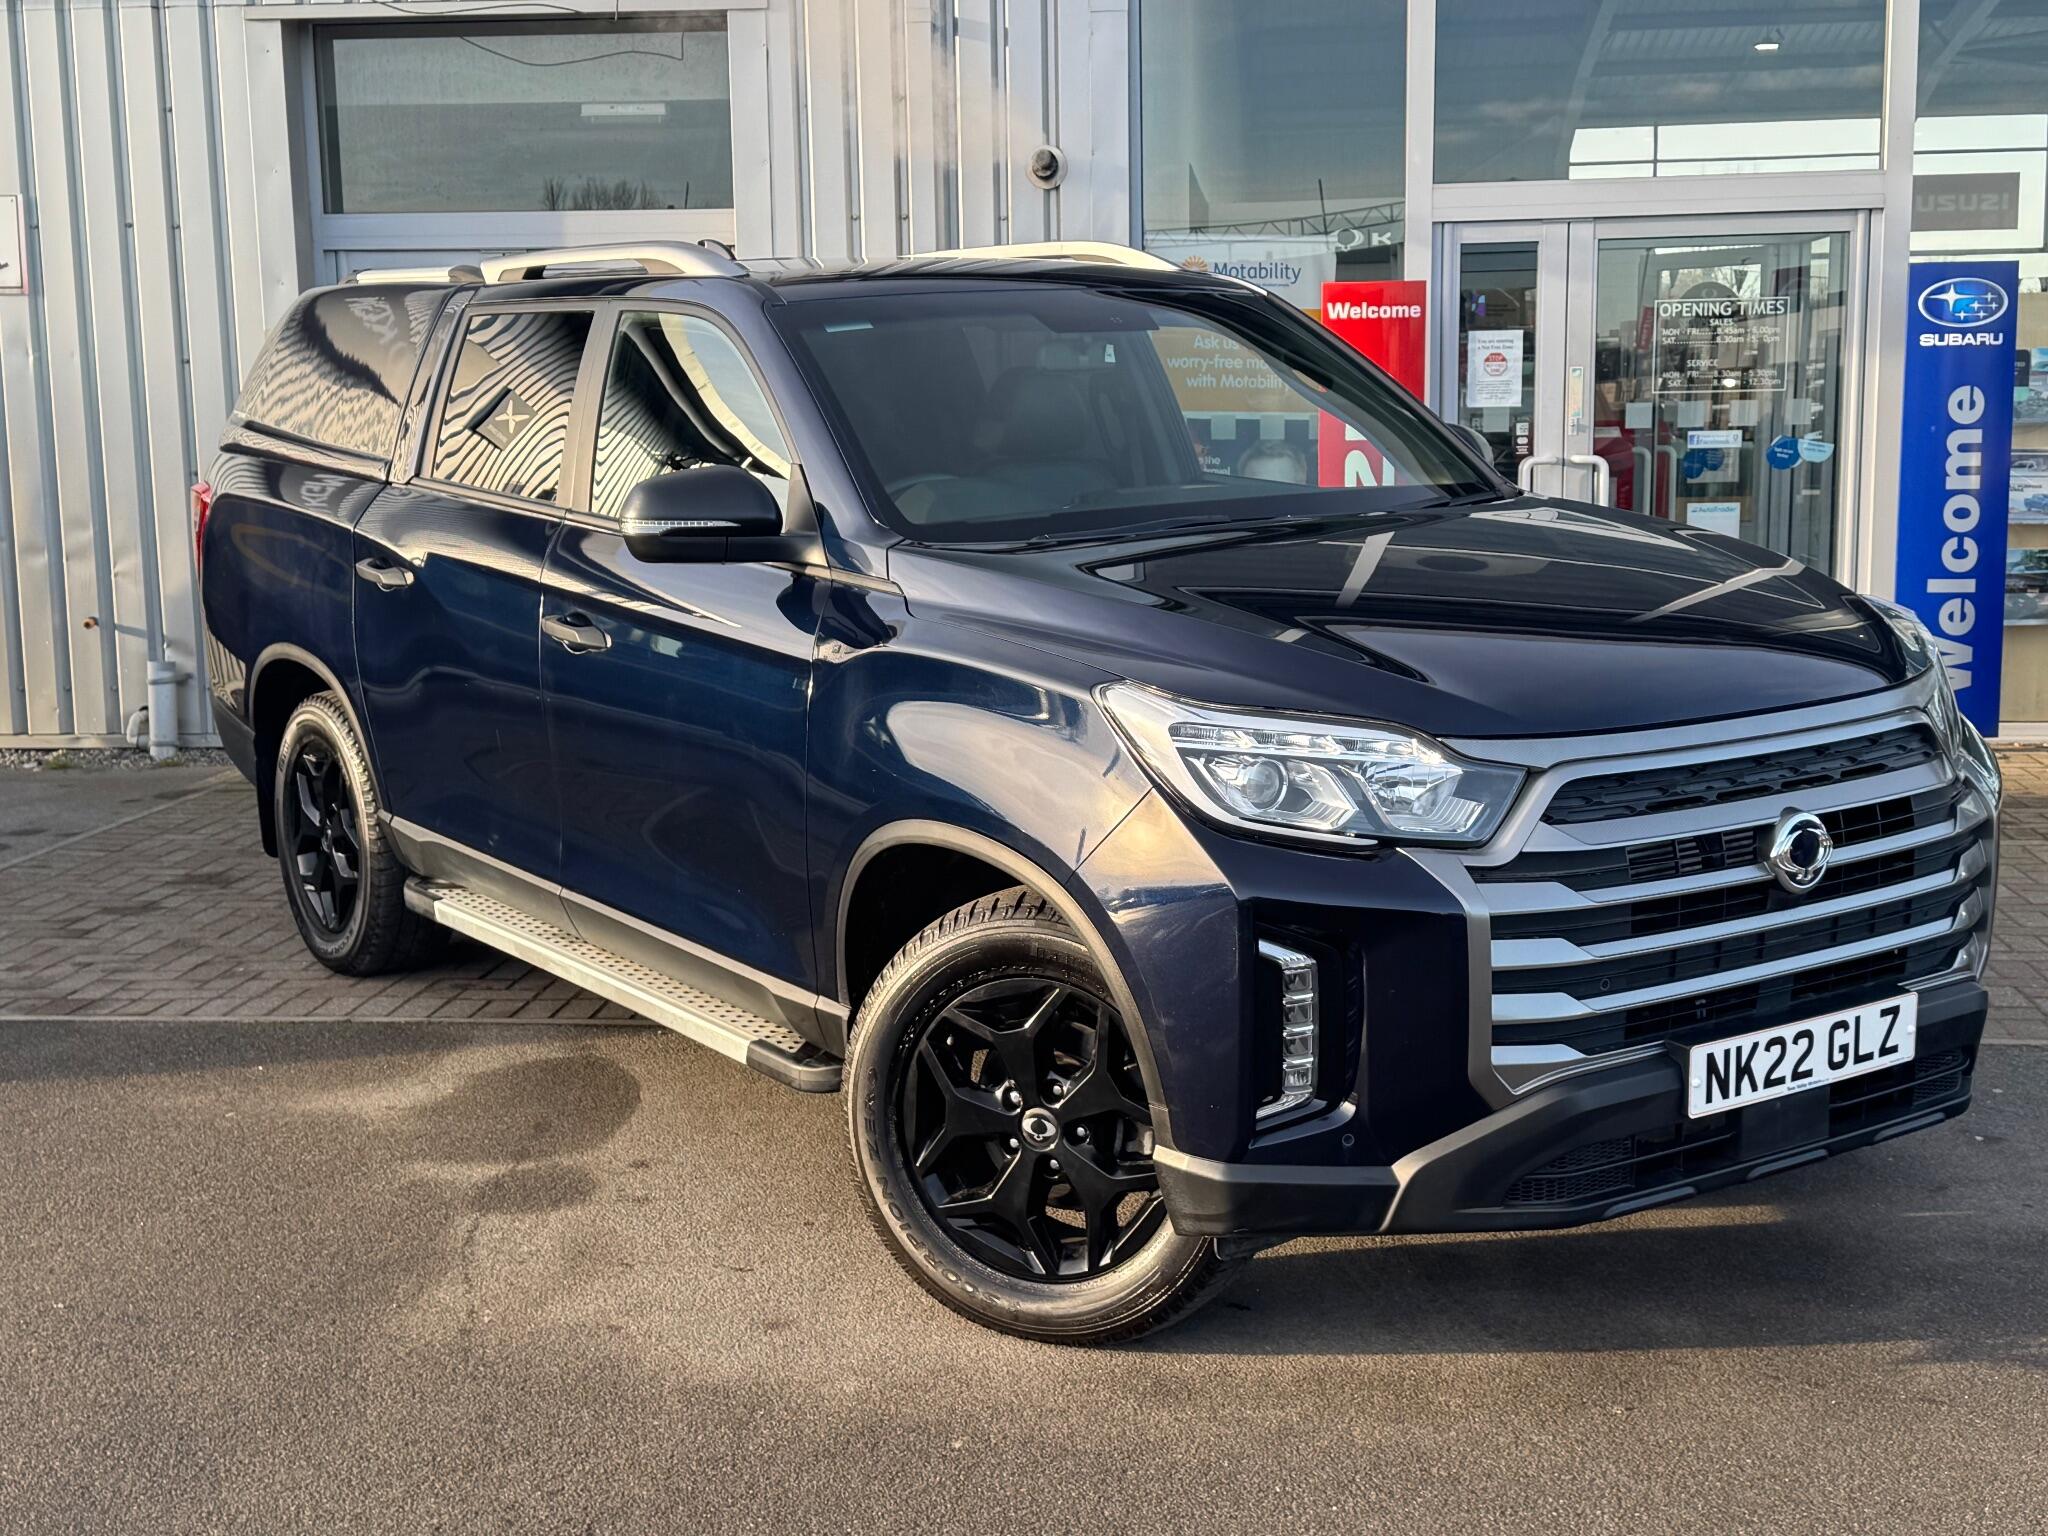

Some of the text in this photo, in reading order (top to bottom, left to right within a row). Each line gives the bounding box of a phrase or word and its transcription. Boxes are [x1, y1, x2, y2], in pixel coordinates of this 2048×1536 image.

[1213, 261, 1302, 285] Motability
[1327, 301, 1422, 320] Welcome
[1659, 300, 1785, 317] OPENING TIMES
[1709, 318, 1734, 327] SALES
[1662, 328, 1680, 336] MON
[1919, 333, 2003, 346] SUBARU
[1193, 334, 1220, 350] Ask
[1166, 354, 1244, 372] worry-free
[1686, 359, 1719, 368] SERVICE
[1186, 374, 1217, 388] with
[1926, 385, 1985, 692] Welcome
[1705, 1004, 1901, 1105] NK22 GLZ
